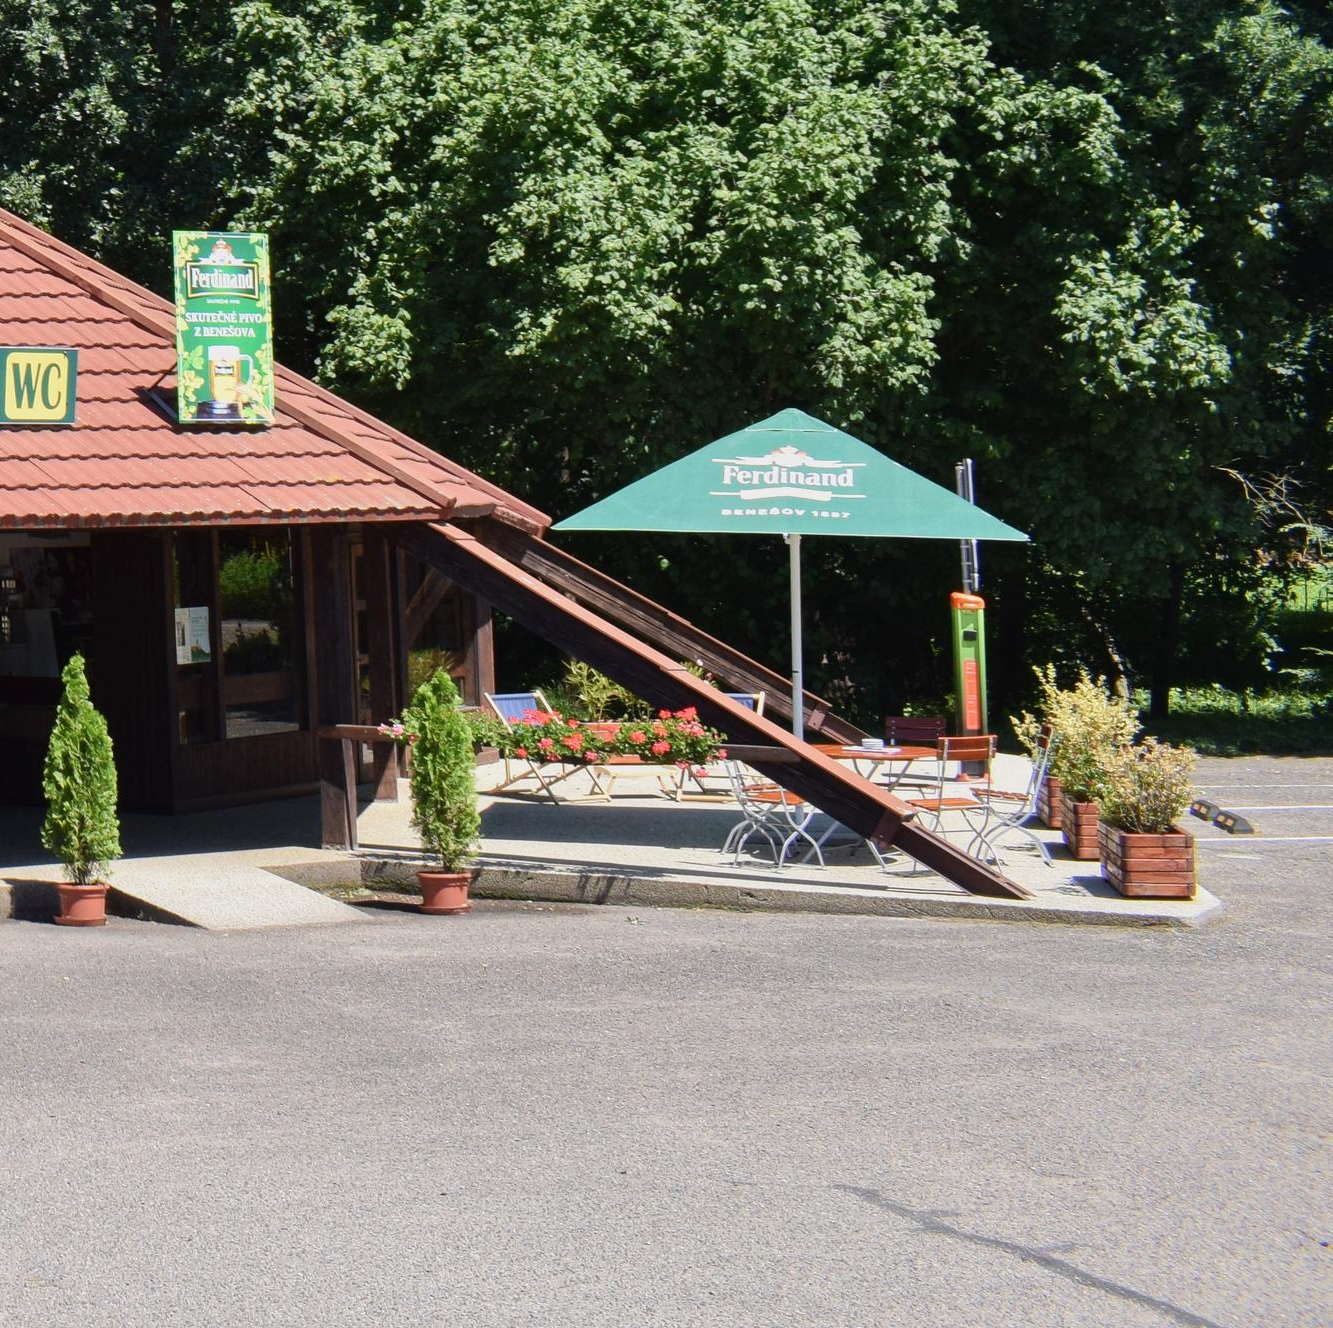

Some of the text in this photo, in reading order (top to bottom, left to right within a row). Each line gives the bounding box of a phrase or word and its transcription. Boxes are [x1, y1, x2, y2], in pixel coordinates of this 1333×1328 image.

[190, 267, 253, 289] Ferdinand
[185, 310, 262, 324] SKUTEČNÉ PIVO
[194, 324, 256, 337] Z BENEŠOVA
[11, 362, 62, 410] WC
[722, 464, 854, 487] Ferdinand
[721, 507, 806, 517] BENEŠOV
